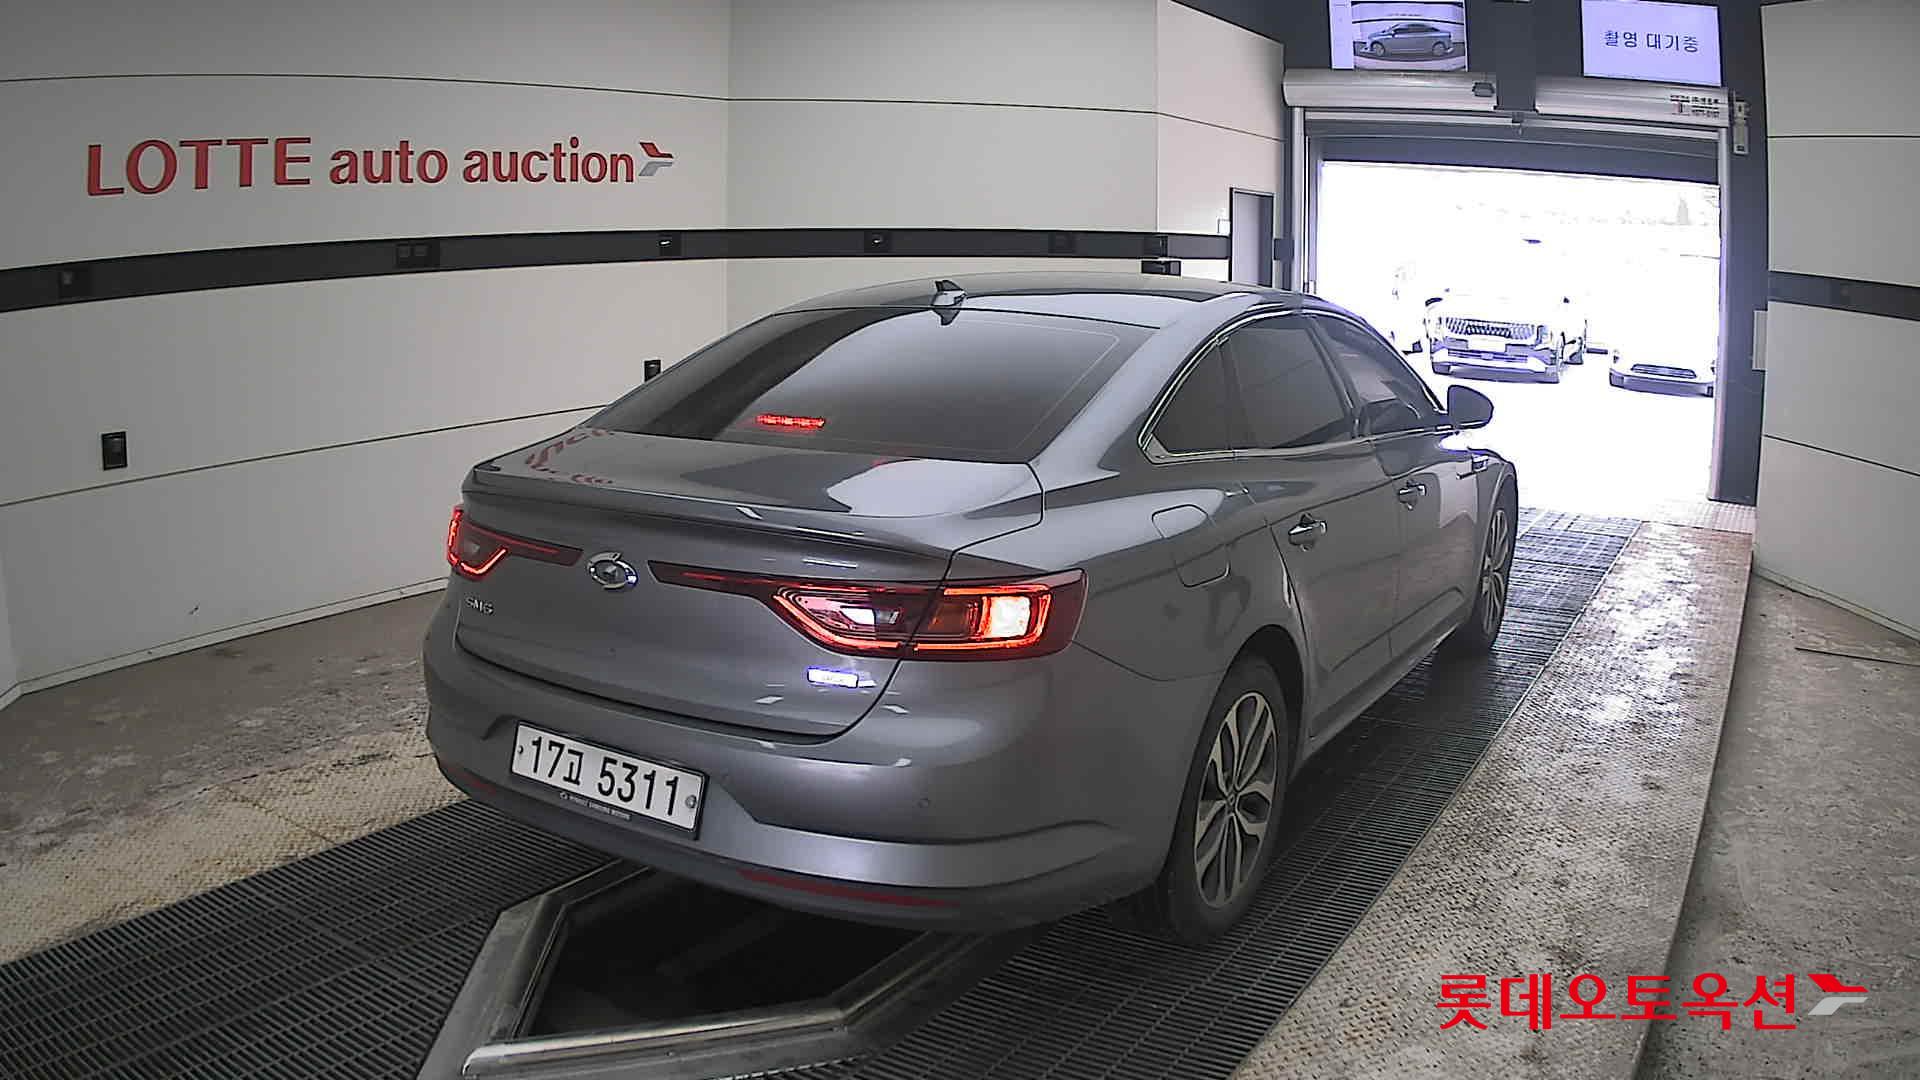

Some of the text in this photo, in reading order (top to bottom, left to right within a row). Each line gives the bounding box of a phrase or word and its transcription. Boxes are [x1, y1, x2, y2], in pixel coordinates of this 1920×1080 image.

[1604, 30, 1699, 53] 촬영 대기중
[87, 136, 635, 197] LOTTE auto auction
[531, 736, 584, 786] 17고
[597, 756, 680, 816] 5311
